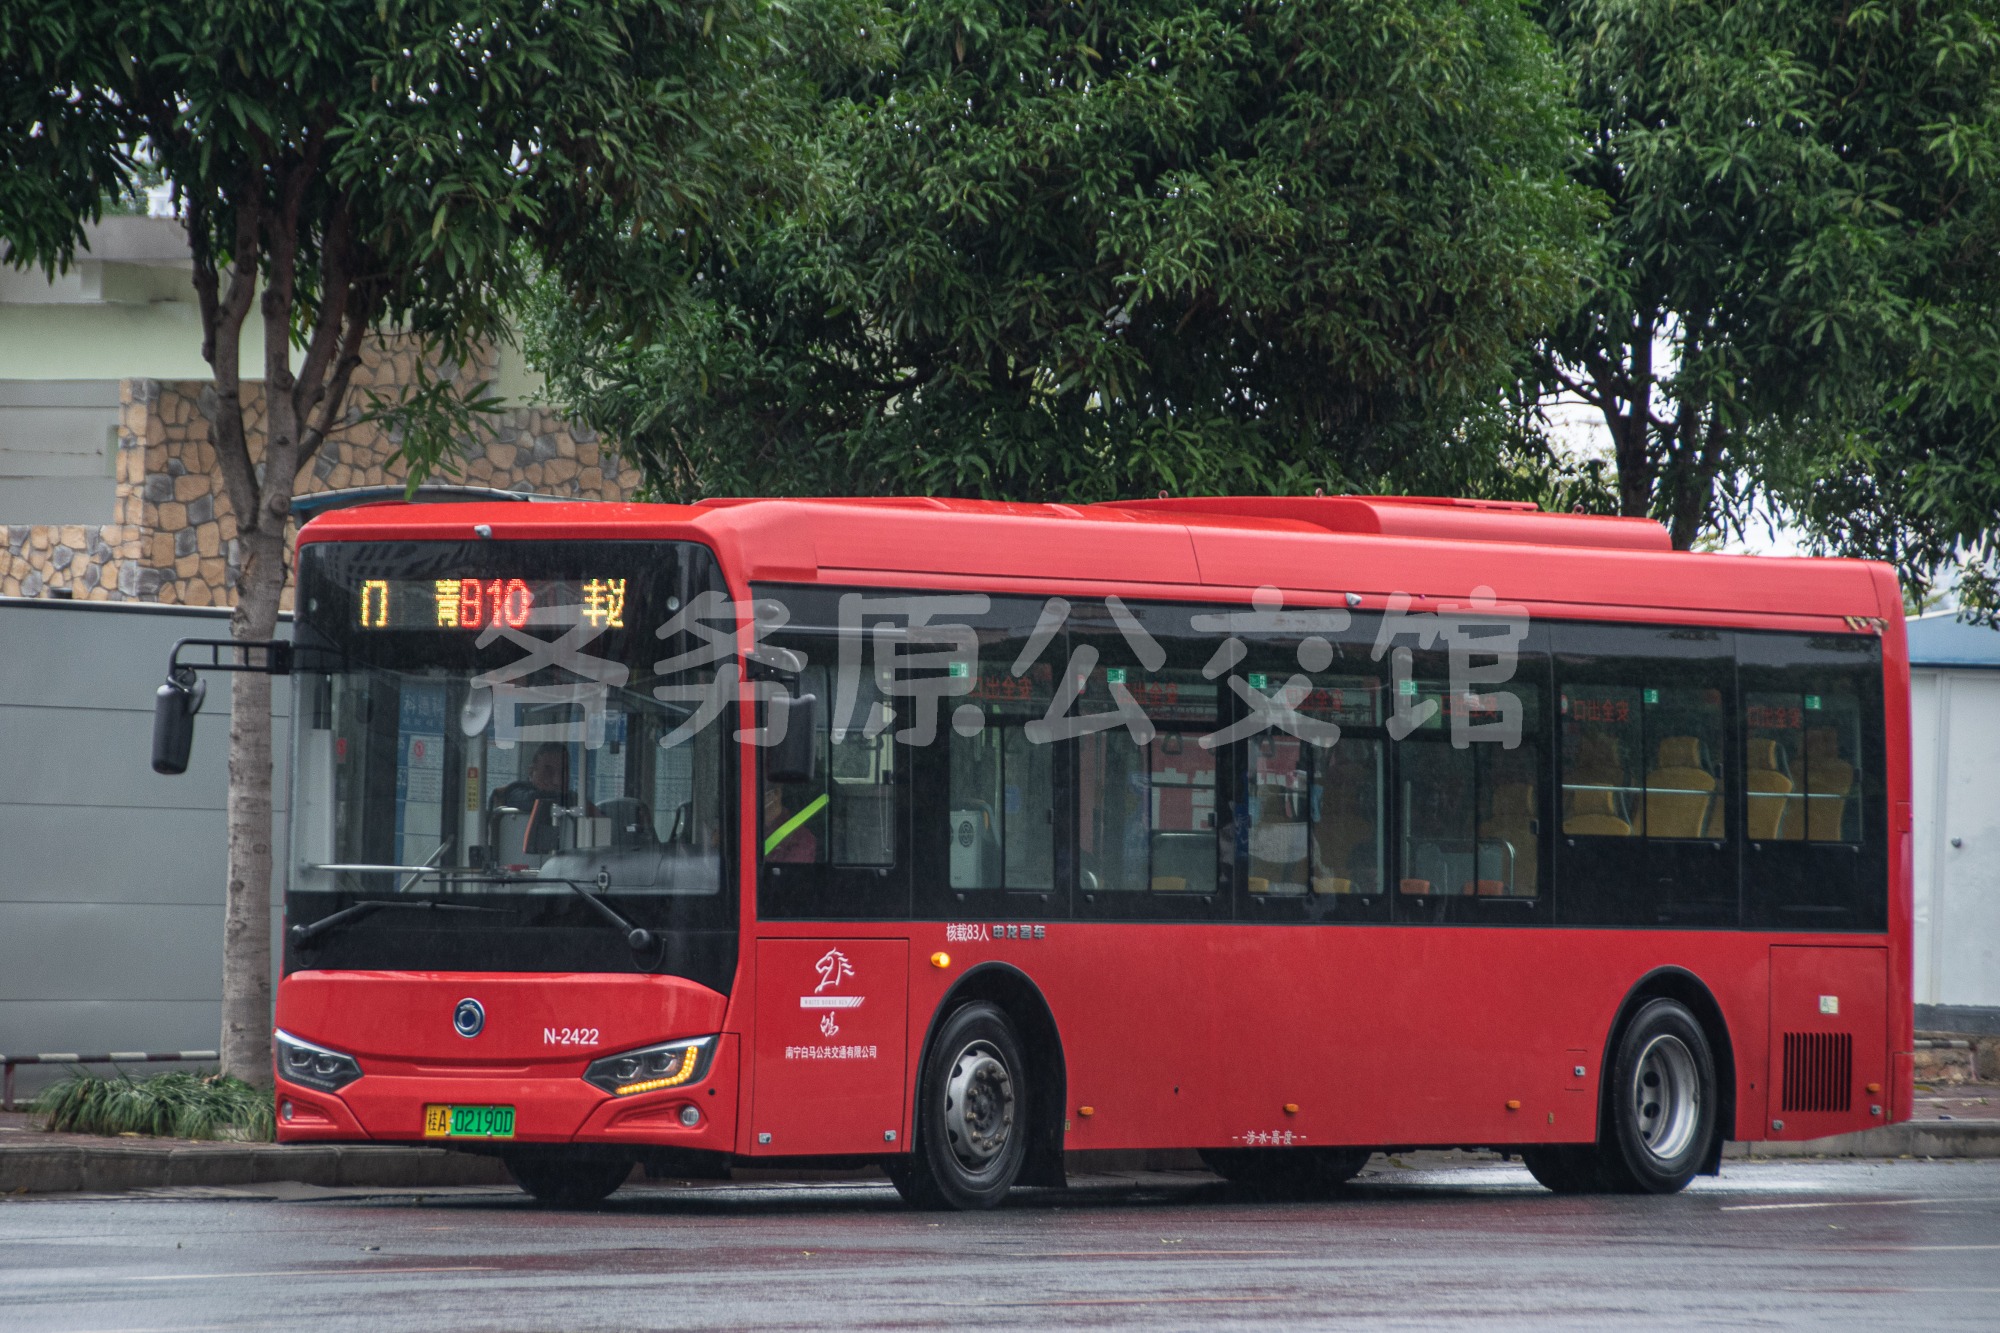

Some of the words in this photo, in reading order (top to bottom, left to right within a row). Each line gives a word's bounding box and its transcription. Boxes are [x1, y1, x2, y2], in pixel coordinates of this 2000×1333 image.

[460, 578, 529, 628] B10
[946, 923, 989, 942] 核载83人
[992, 924, 1045, 939] 申龙客车
[543, 1027, 598, 1045] N-2422
[785, 1045, 877, 1059] 南宁白马公共交通有限公司
